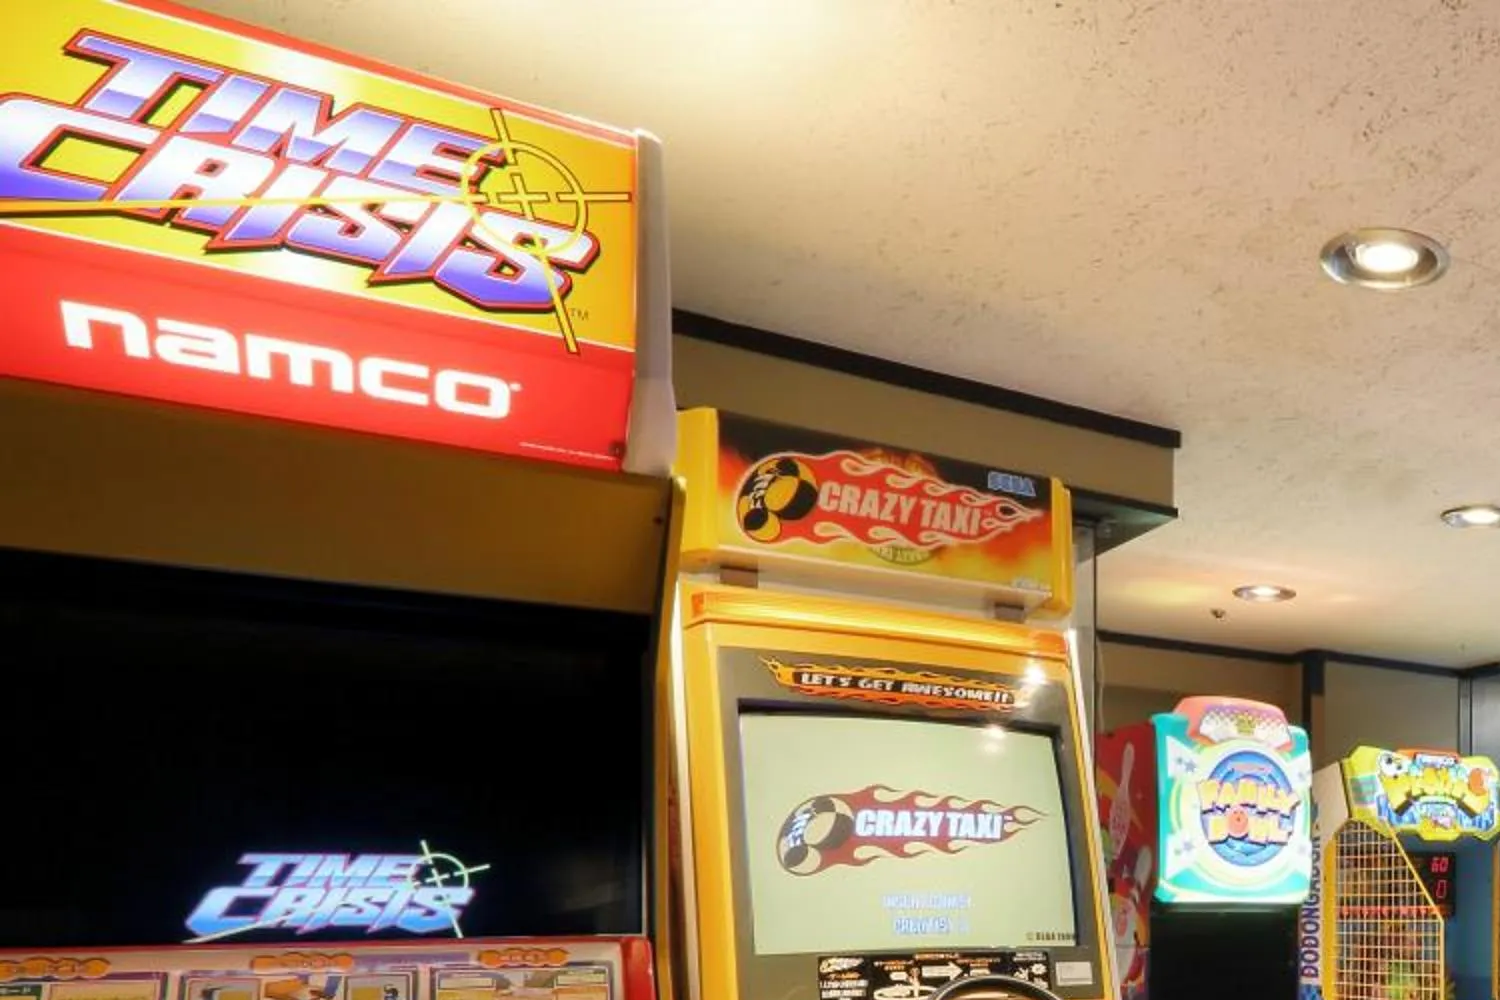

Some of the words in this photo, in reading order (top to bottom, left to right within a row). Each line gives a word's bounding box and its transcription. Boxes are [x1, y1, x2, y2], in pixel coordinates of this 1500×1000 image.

[64, 28, 506, 196] TIME
[0, 94, 599, 311] CRISIS
[60, 300, 513, 420] namco
[818, 480, 917, 525] CRAZY
[919, 498, 982, 536] TAXI
[987, 471, 1037, 498] SEGA
[800, 671, 851, 689] LET'S
[857, 676, 894, 692] GET
[900, 681, 1012, 706] AWESOME!!
[855, 809, 941, 838] CRAZY
[946, 810, 1002, 839] TAXI
[238, 852, 424, 889] TIME
[186, 886, 473, 934] CRISIS
